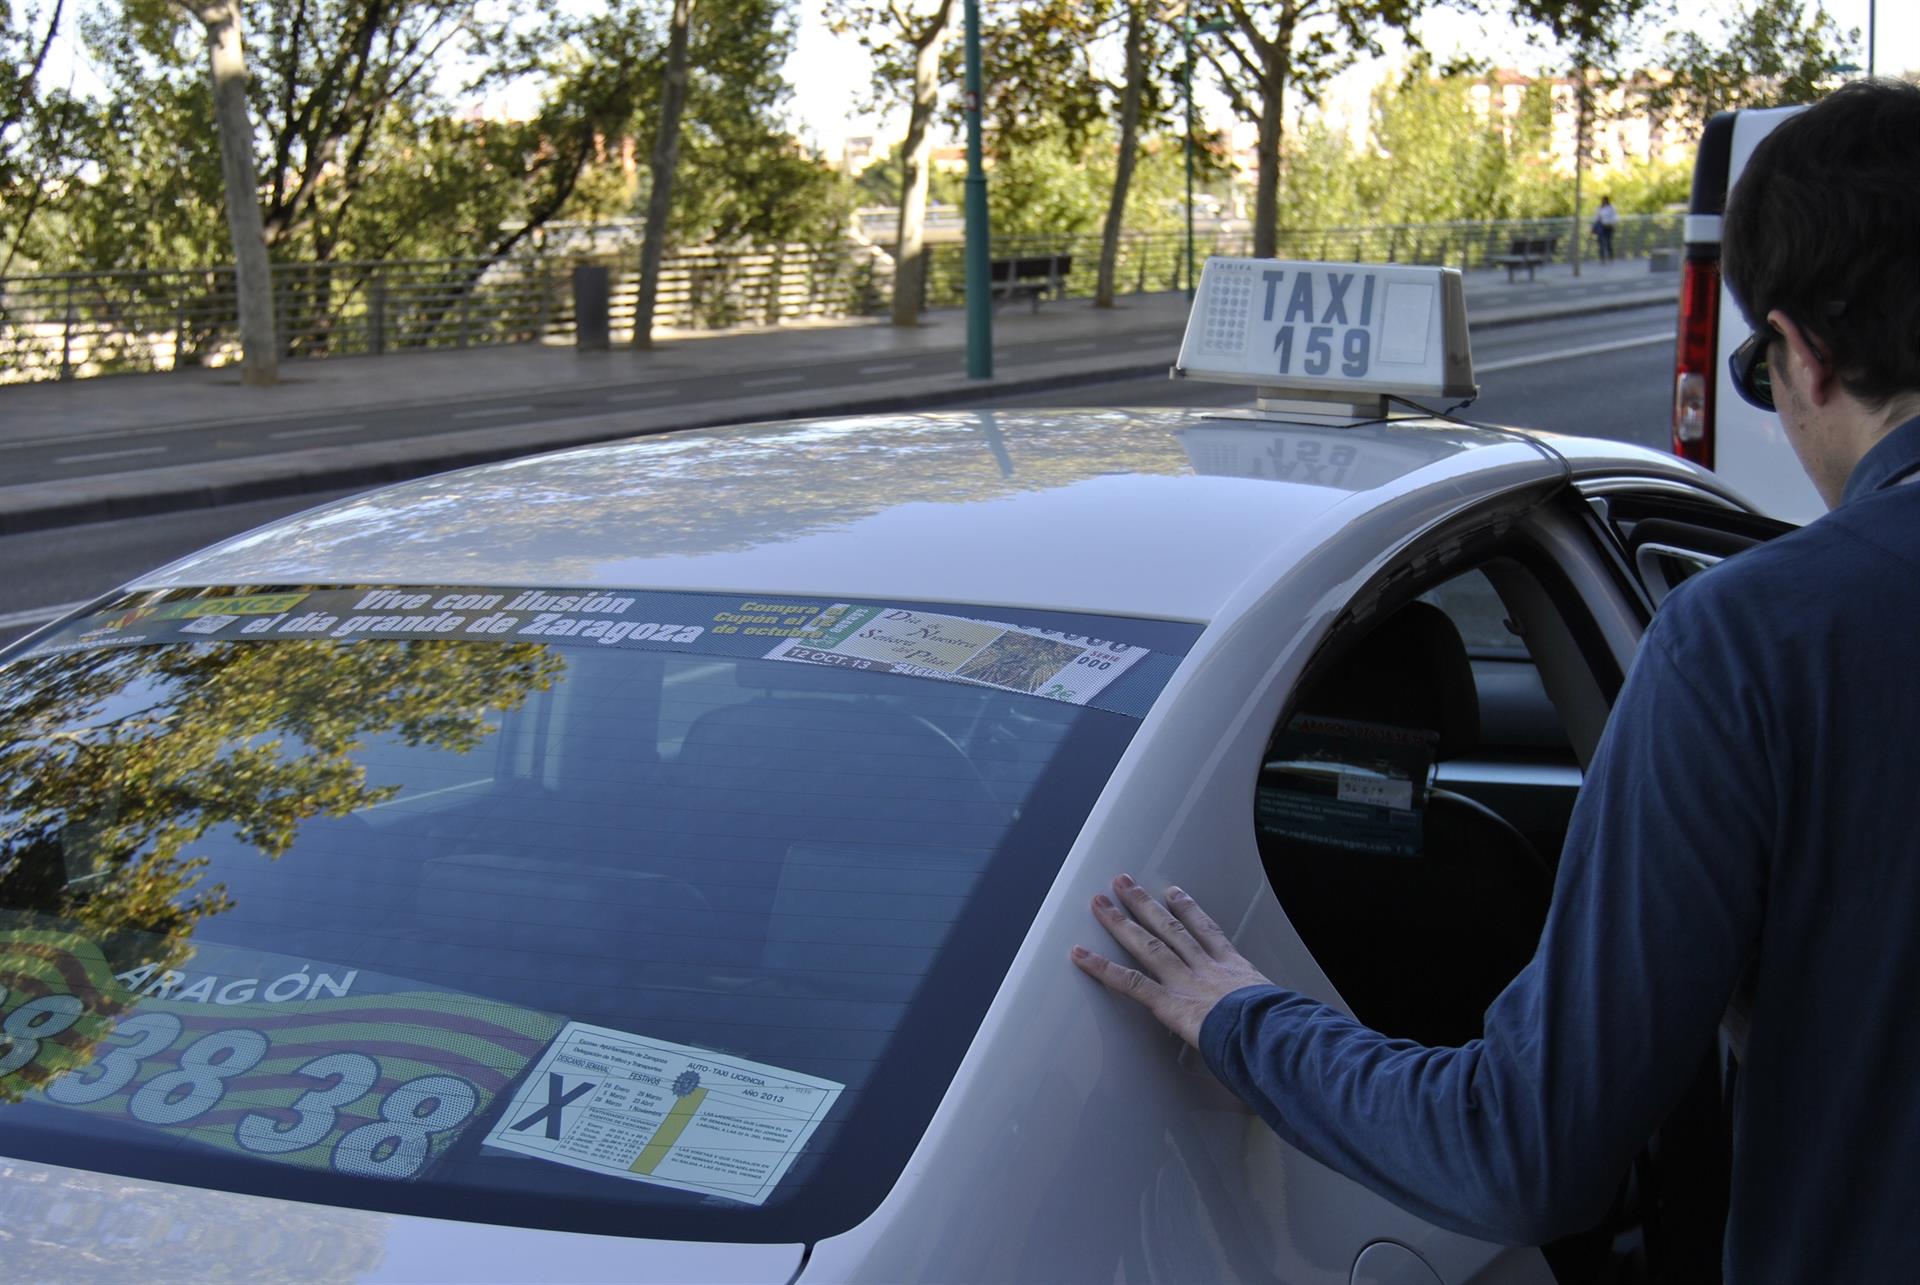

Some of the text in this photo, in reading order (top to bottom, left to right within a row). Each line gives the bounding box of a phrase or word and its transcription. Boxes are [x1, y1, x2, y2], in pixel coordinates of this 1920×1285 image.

[1213, 262, 1251, 271] TARIFA
[1262, 270, 1375, 326] TAXI
[1273, 326, 1371, 378] 159
[201, 597, 289, 613] ONCE
[352, 590, 636, 614] Vive con ilusión
[740, 602, 820, 614] Compra
[713, 612, 778, 624] Cupón
[240, 612, 704, 645] el día grande de Zaragoza
[712, 624, 825, 639] de octubre
[790, 648, 809, 657] 12
[851, 660, 871, 669] 13
[1077, 656, 1110, 670] 000
[116, 964, 358, 1005] ARAGÓN
[628, 1072, 662, 1085] FESTIVOS
[730, 1072, 767, 1086] LICENCIA
[741, 1087, 786, 1103] AÑO 2013
[510, 1072, 596, 1141] X
